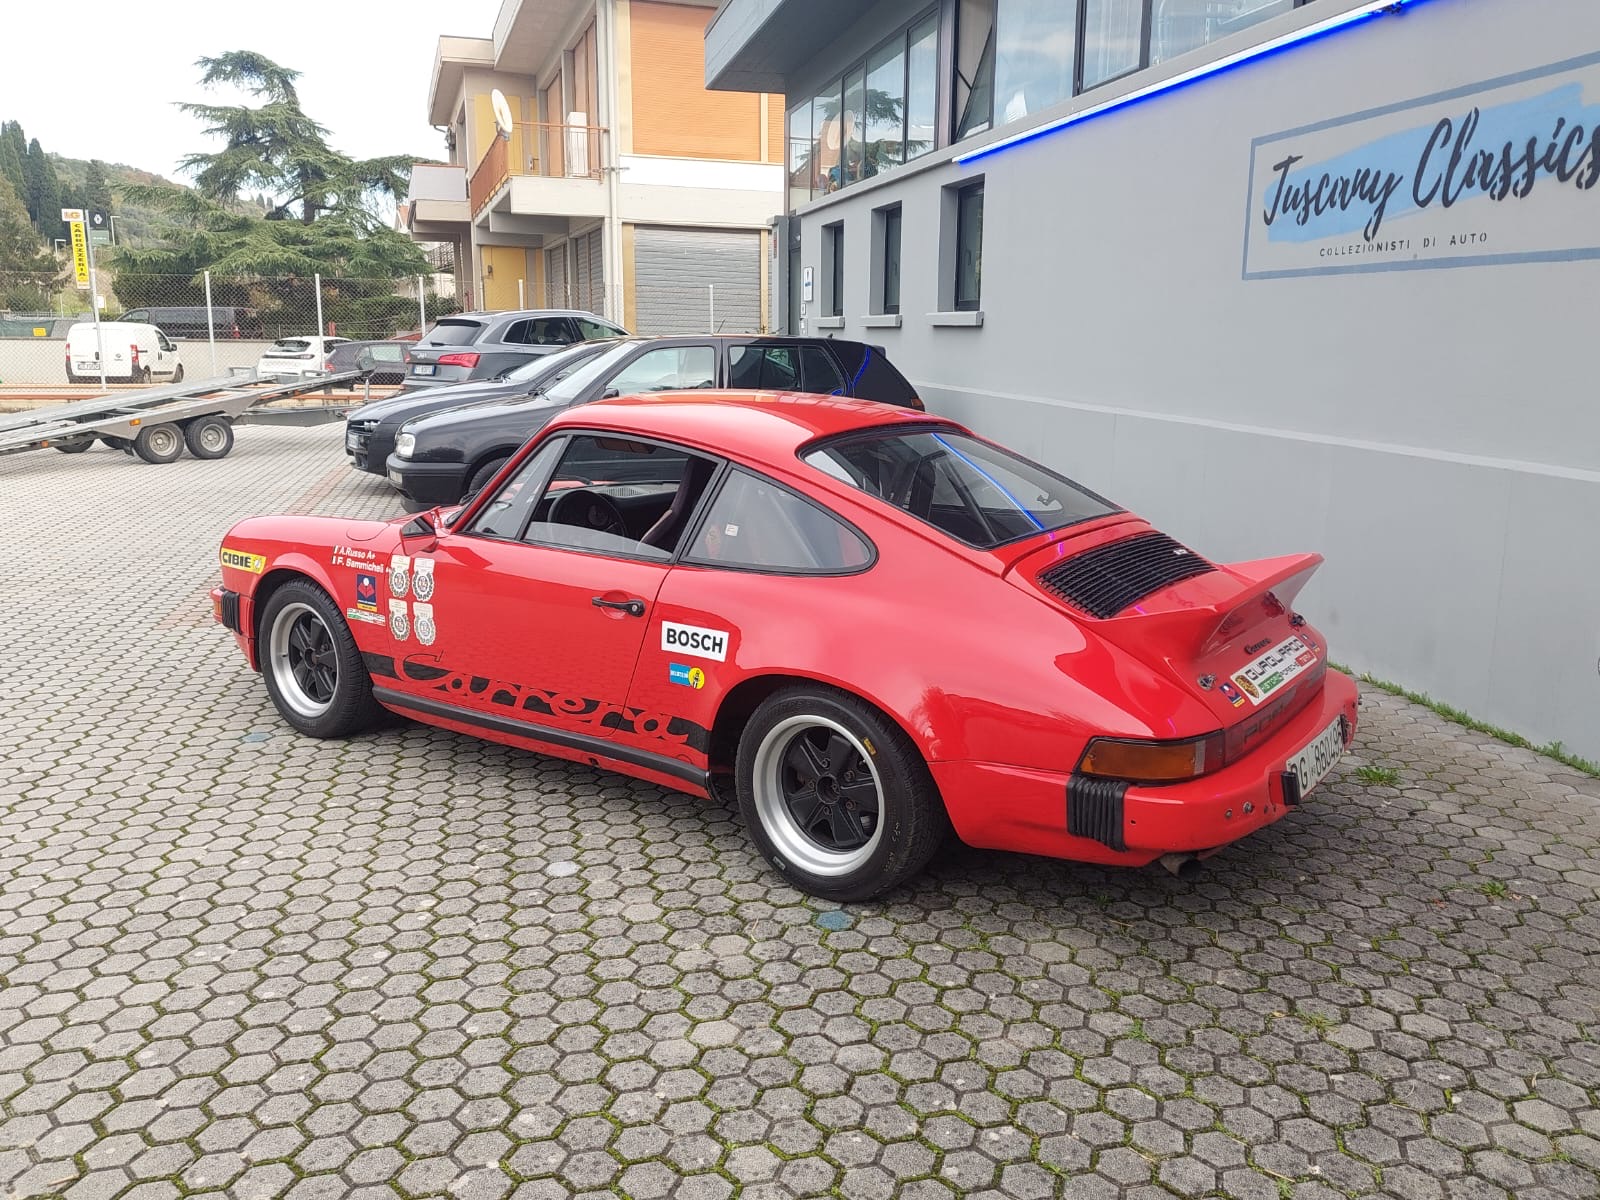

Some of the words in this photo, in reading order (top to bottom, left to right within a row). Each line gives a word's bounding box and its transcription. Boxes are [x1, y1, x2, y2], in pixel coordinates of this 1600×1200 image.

[1263, 155, 1404, 242] Tuscany
[1412, 106, 1600, 208] Classics
[1319, 239, 1411, 257] COLLEZIONISTI
[1423, 237, 1436, 248] DI
[1449, 232, 1488, 246] AUTO
[222, 551, 252, 568] CIBIE
[666, 627, 724, 654] BOSCH
[393, 650, 689, 745] Carrera
